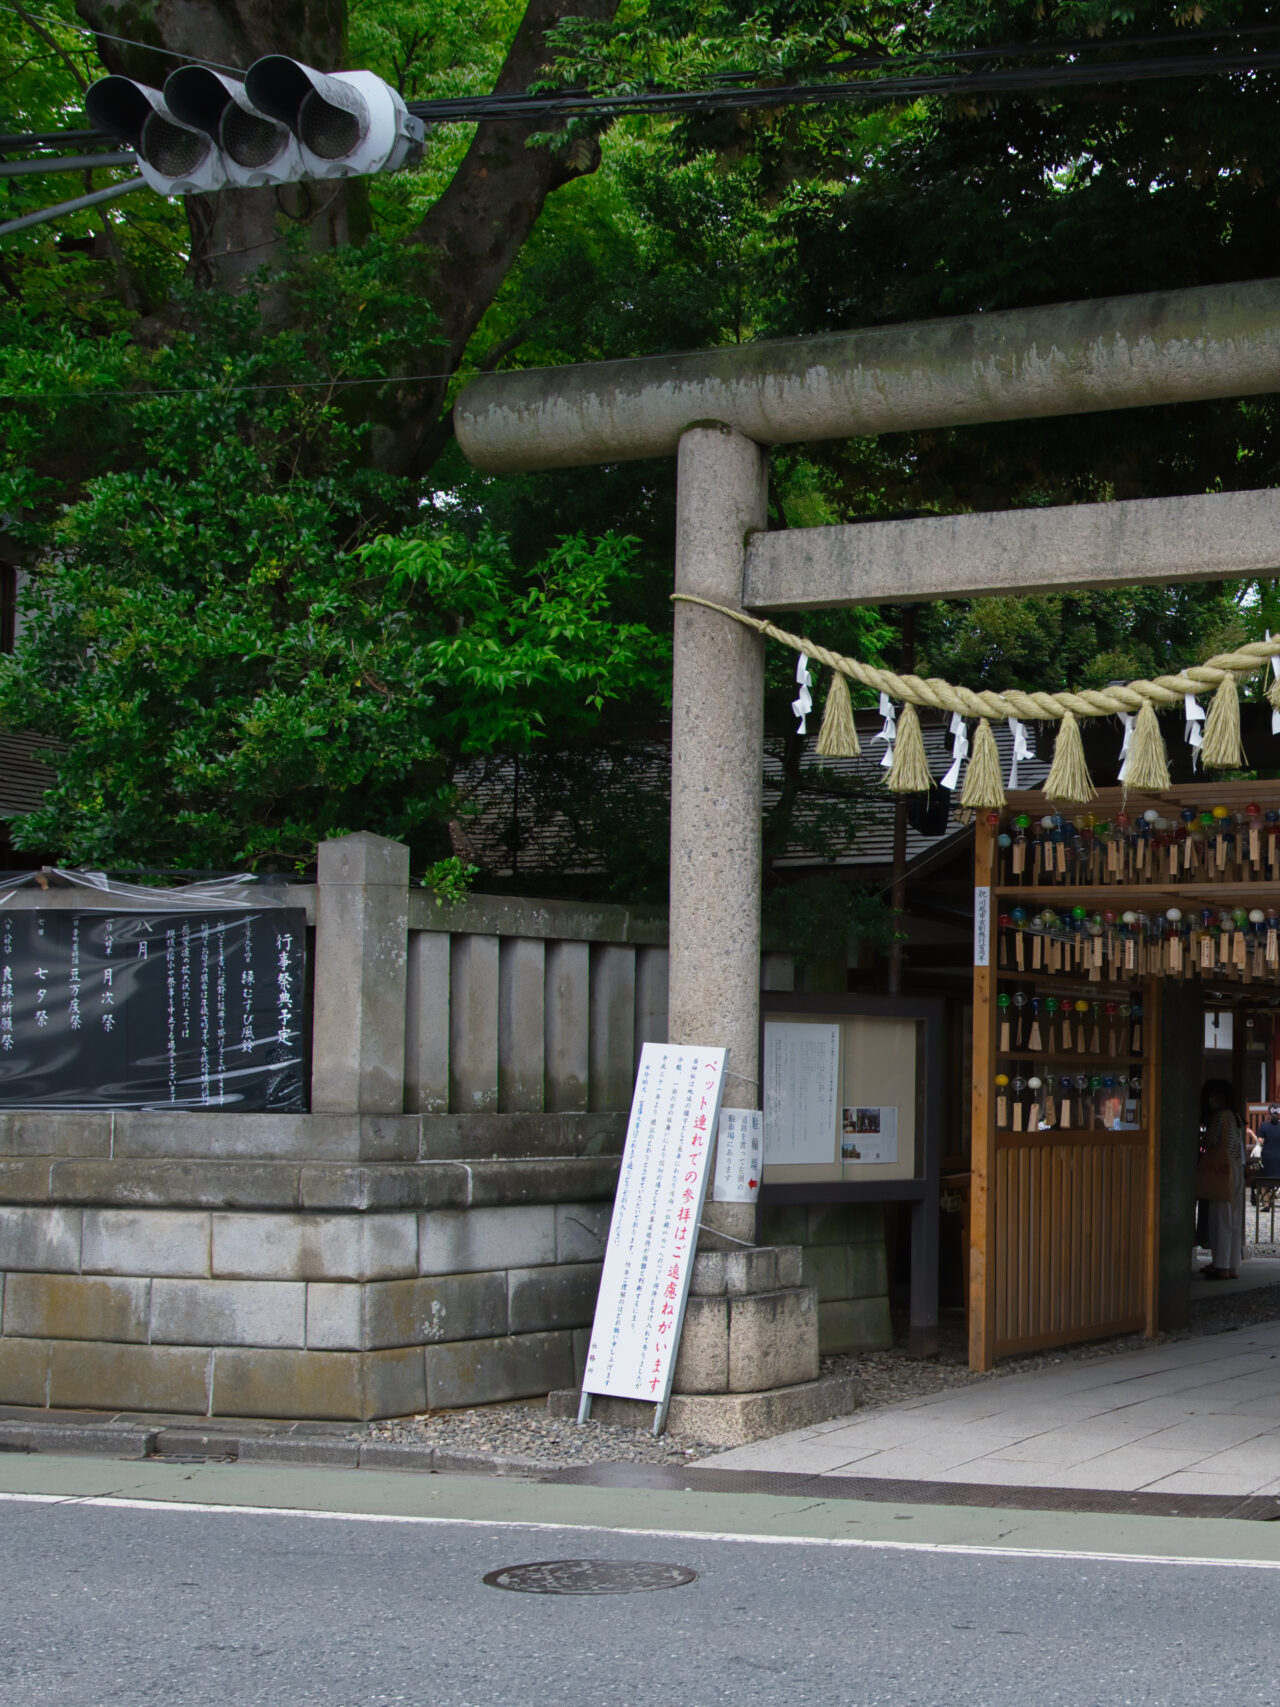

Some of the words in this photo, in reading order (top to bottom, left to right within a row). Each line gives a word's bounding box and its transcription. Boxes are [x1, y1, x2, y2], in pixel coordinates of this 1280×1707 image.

[136, 920, 153, 960] 八月
[1, 967, 14, 1051] 良縁祈願祭
[34, 967, 49, 1028] 七夕祭
[101, 968, 116, 1033] 月次祭
[241, 970, 256, 1053] 縁むすび風鈴
[276, 934, 294, 1047] 行事祭典予定
[646, 1059, 718, 1394] ペット連れでの参拝はご遠慮ねがいます
